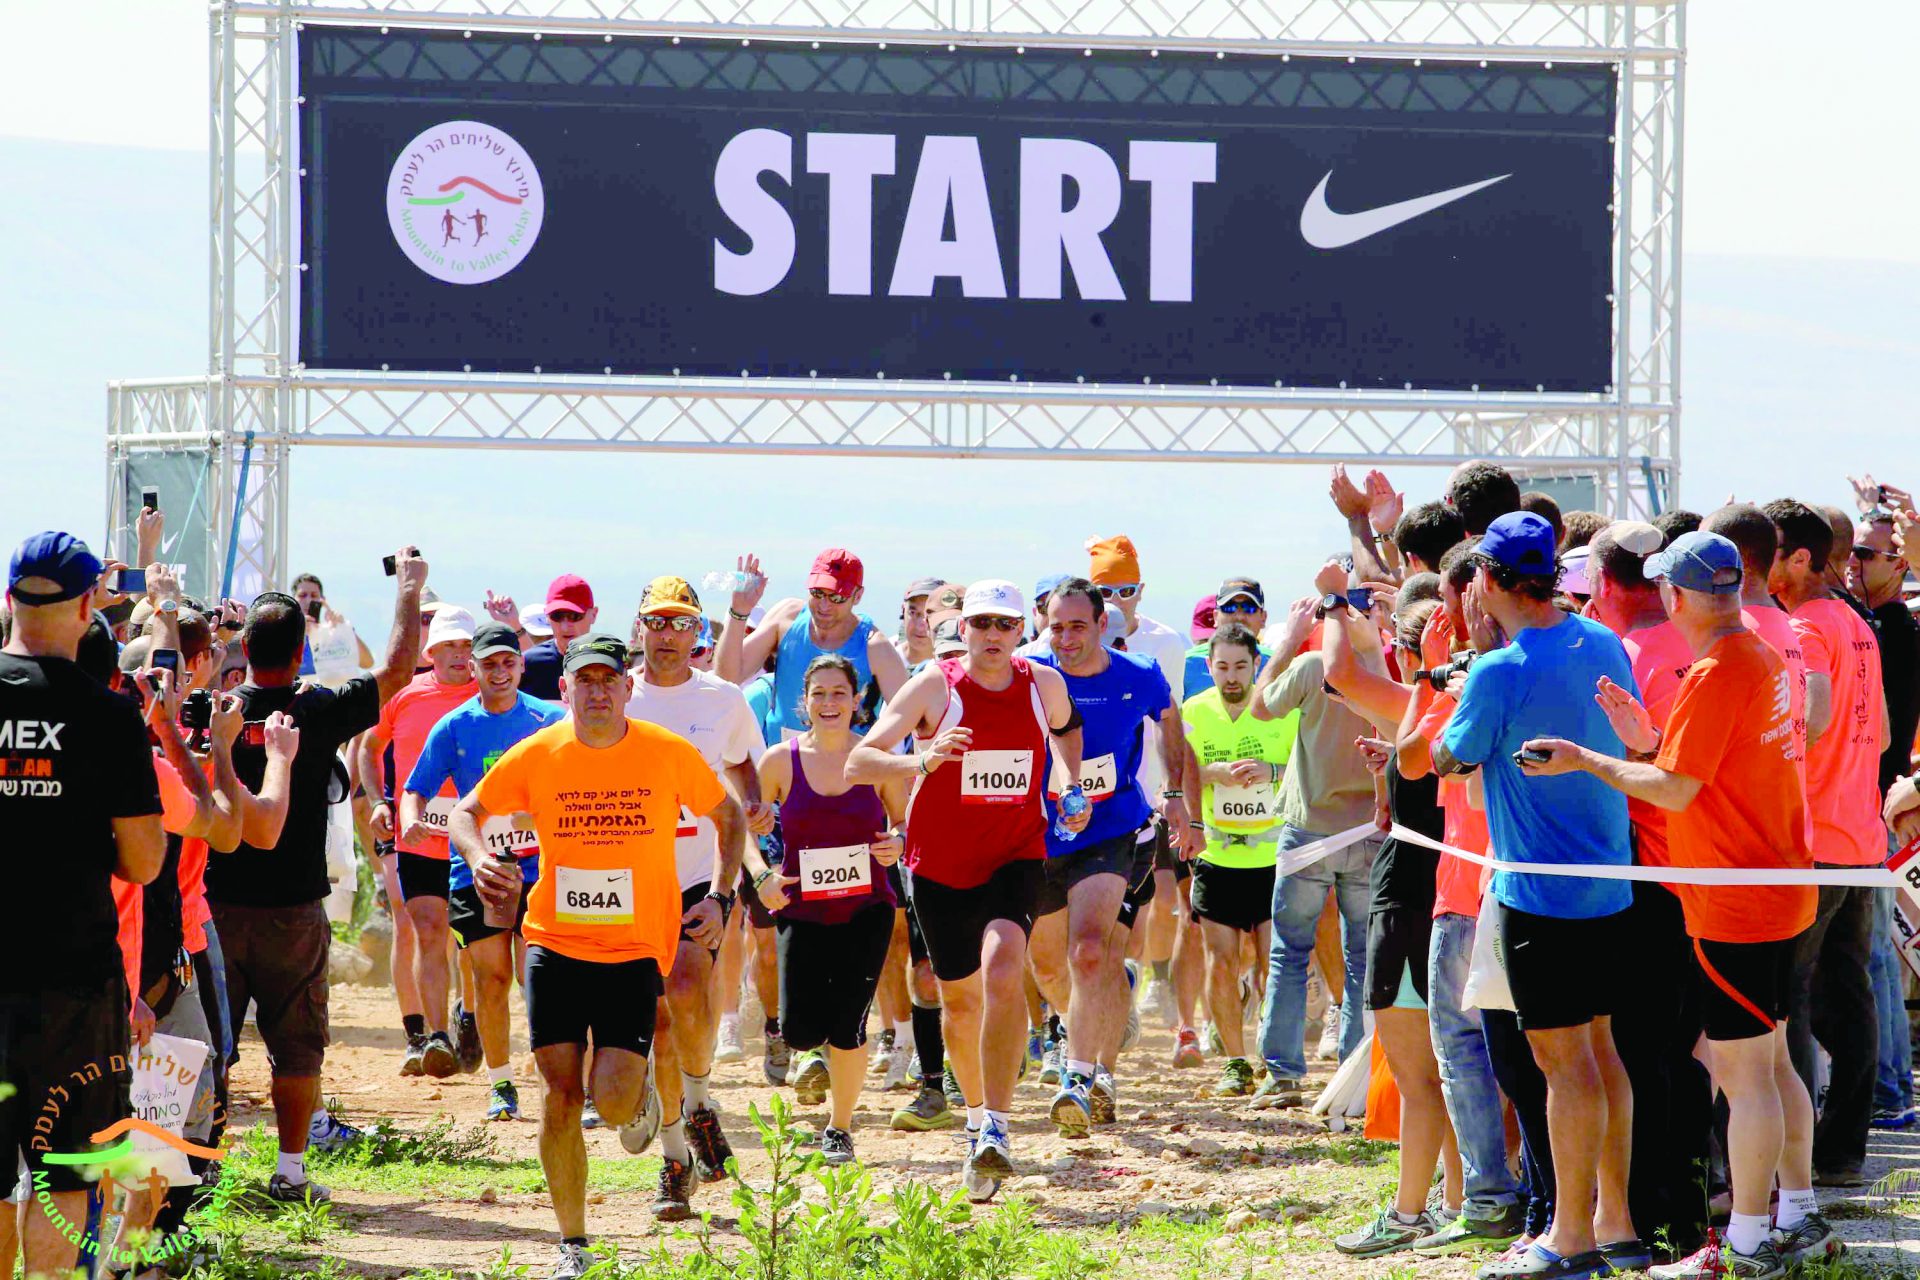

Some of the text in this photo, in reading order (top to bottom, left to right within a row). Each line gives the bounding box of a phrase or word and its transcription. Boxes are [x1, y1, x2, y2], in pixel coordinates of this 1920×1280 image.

[400, 133, 529, 198] מירוץ שליחים הר לעמק
[714, 127, 1217, 302] START
[401, 208, 533, 272] Mountain to Valley Relay
[968, 772, 1027, 789] 1100A
[583, 791, 598, 801] קם
[600, 790, 618, 800] אני
[620, 789, 634, 798] יום
[637, 787, 651, 797] כל
[594, 802, 616, 811] היום
[619, 800, 642, 810] אבל
[1222, 802, 1267, 816] 606A
[488, 829, 536, 848] 1117A
[811, 866, 861, 885] 920A
[566, 890, 622, 909] 684A
